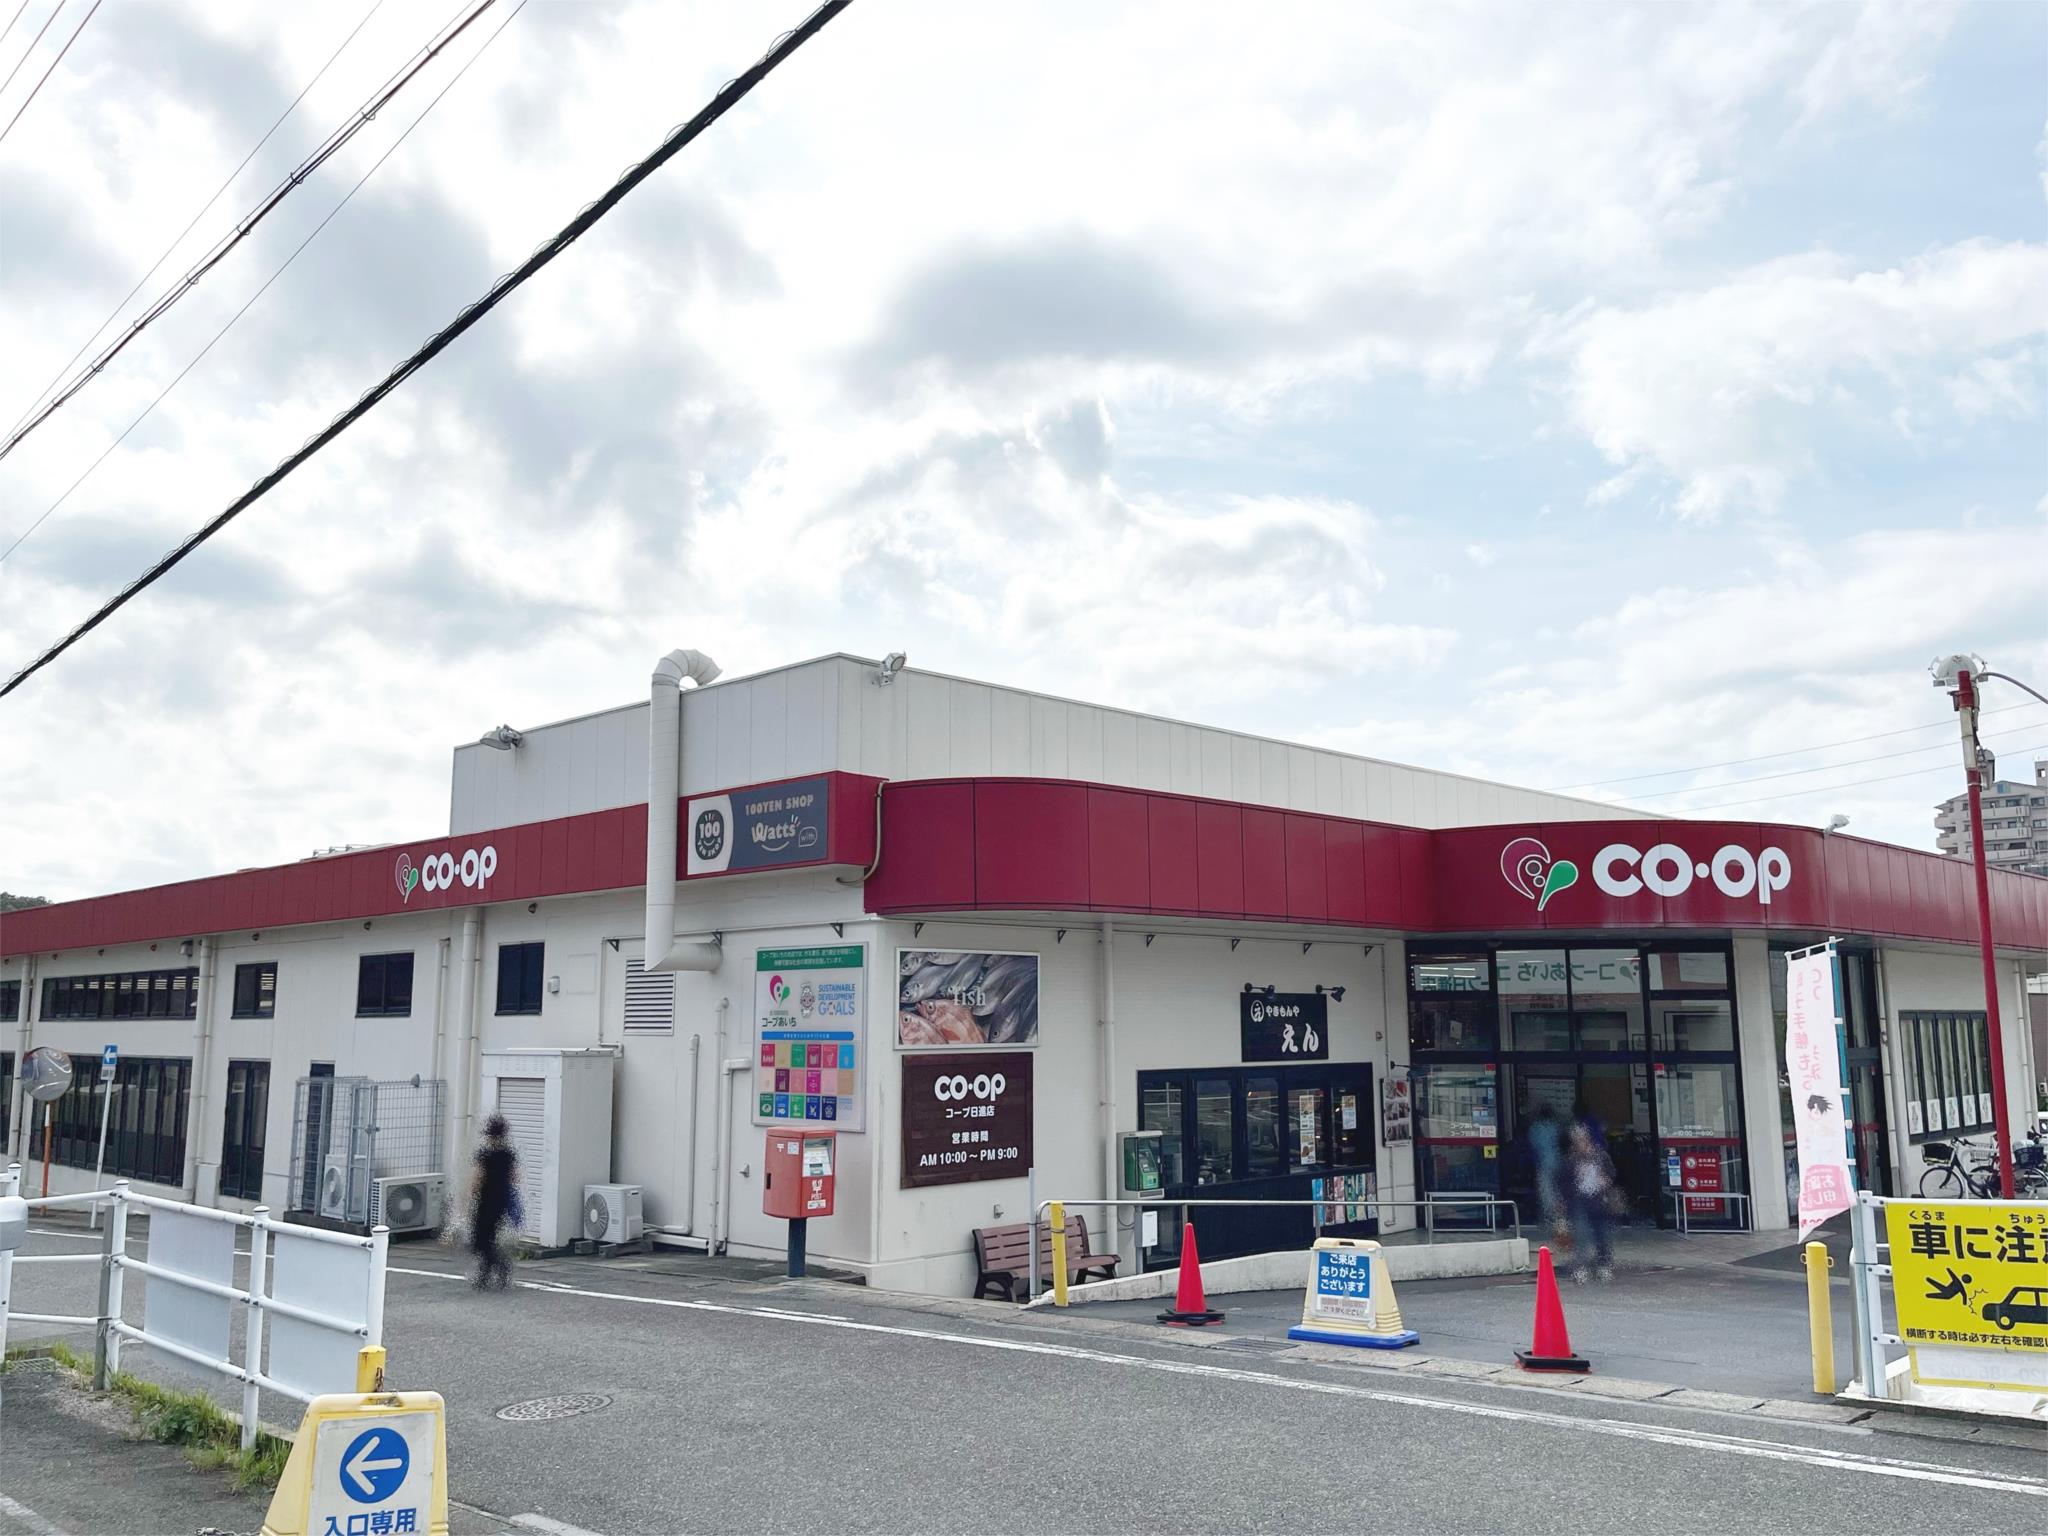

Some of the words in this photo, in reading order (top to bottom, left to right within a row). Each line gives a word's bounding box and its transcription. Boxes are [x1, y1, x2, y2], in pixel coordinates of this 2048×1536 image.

[745, 800, 782, 815] 100YEN
[786, 794, 814, 809] SHOP
[700, 821, 720, 838] 100
[752, 822, 796, 843] Watts
[818, 984, 856, 993] SUSTAINABLE
[818, 993, 856, 1001] DEVELOPMENT
[954, 986, 986, 1006] fish
[762, 1017, 797, 1027] コープあいち
[1282, 1023, 1319, 1053] えん
[945, 1106, 996, 1119] コープ日進店
[952, 1131, 989, 1144] 営業時間
[920, 1154, 937, 1166] AM
[940, 1150, 967, 1164] 10:00
[980, 1149, 996, 1161] PM
[998, 1147, 1018, 1160] 9:00
[1909, 1210, 1945, 1221] くるま
[1909, 1222, 2048, 1264] 車に注
[1330, 1253, 1357, 1266] ご来店
[1320, 1266, 1366, 1280] ありがとう
[1320, 1279, 1366, 1293] ございます
[324, 1508, 417, 1536] 入口専用
